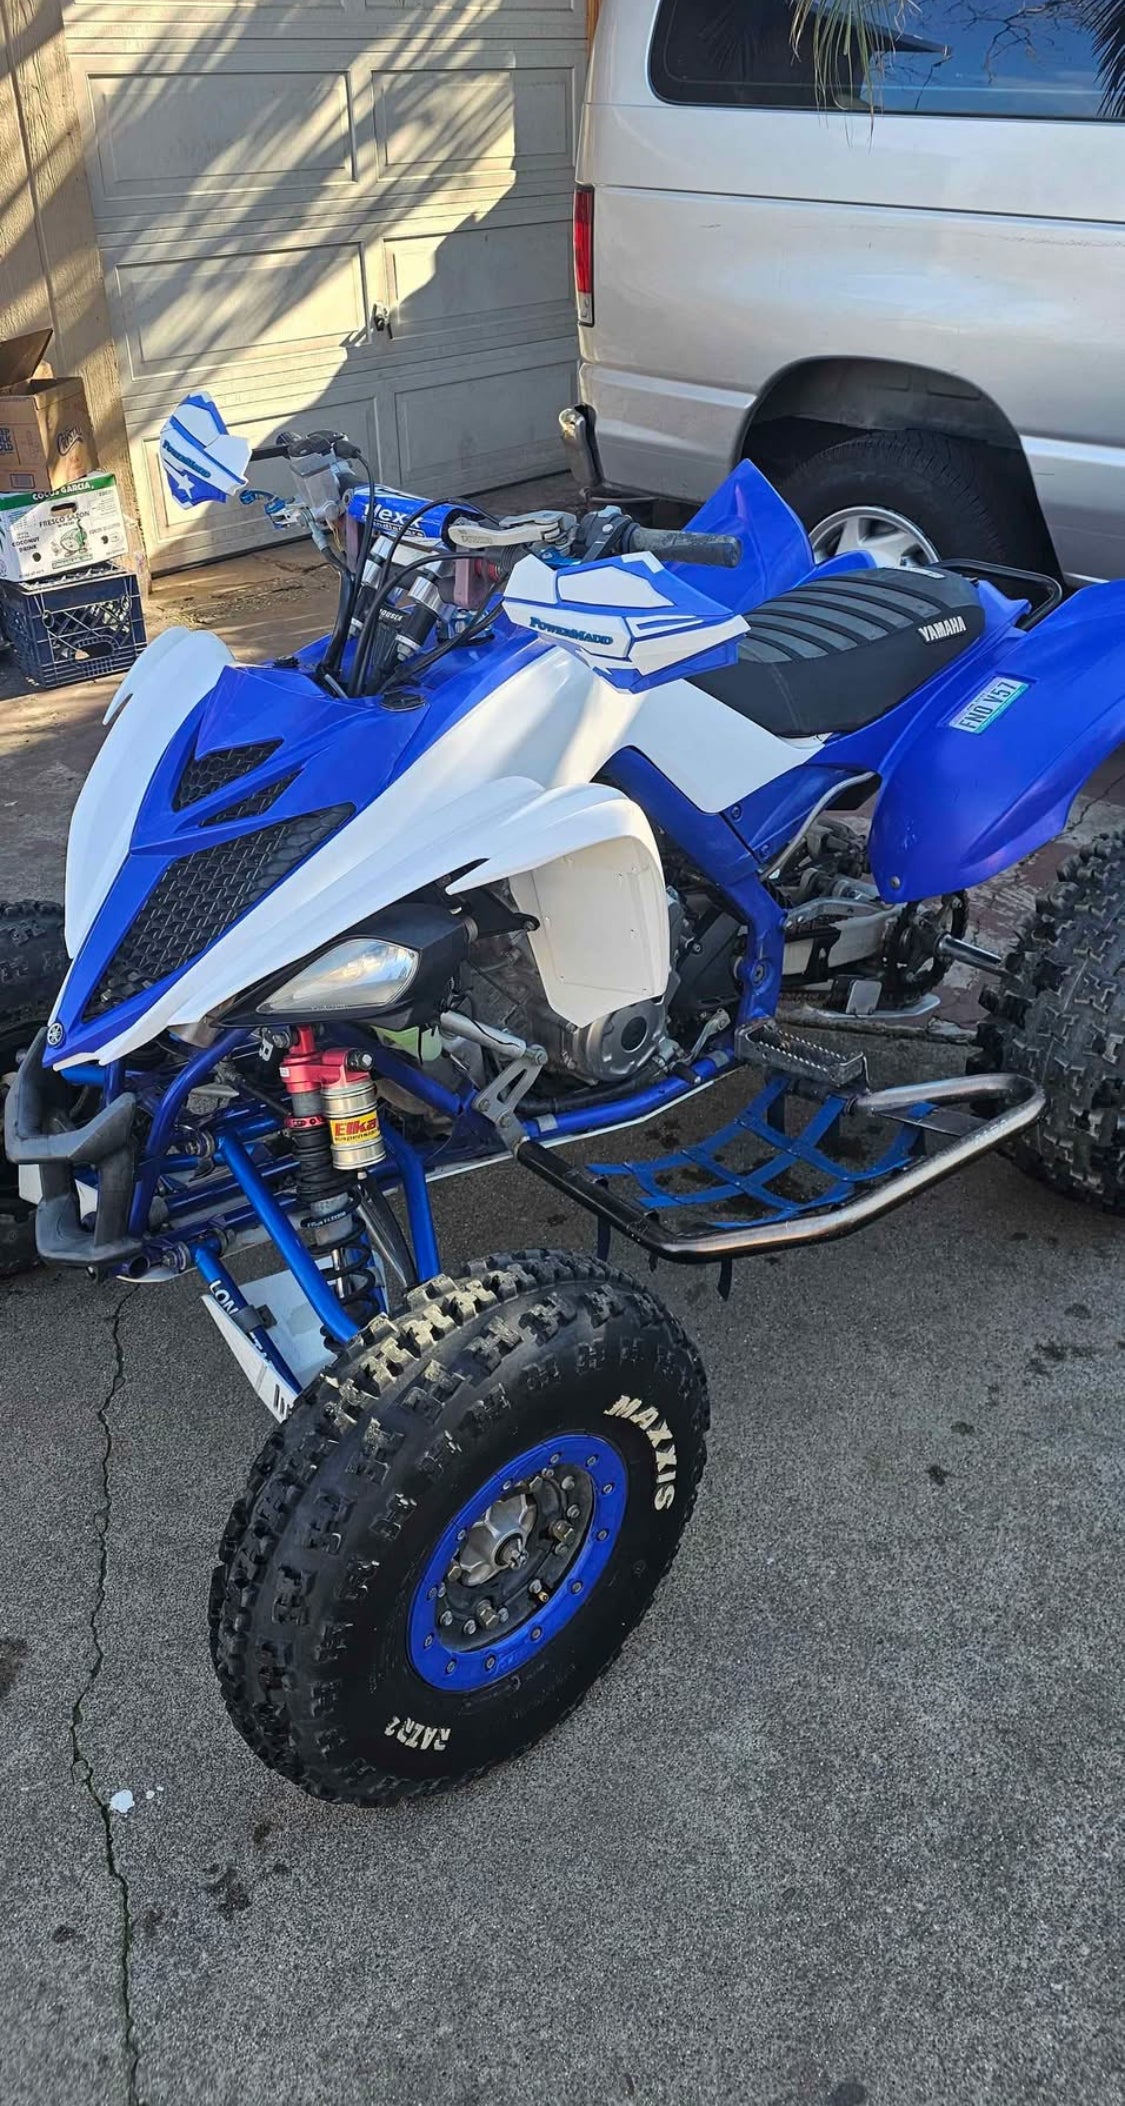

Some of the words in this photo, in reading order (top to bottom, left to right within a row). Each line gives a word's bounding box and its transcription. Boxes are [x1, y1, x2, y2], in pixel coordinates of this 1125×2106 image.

[918, 616, 967, 642] YAMAHA
[983, 682, 1017, 703] V57
[335, 1118, 377, 1137] Elka
[209, 1280, 240, 1316] LON
[603, 1394, 678, 1511] MAXXIS
